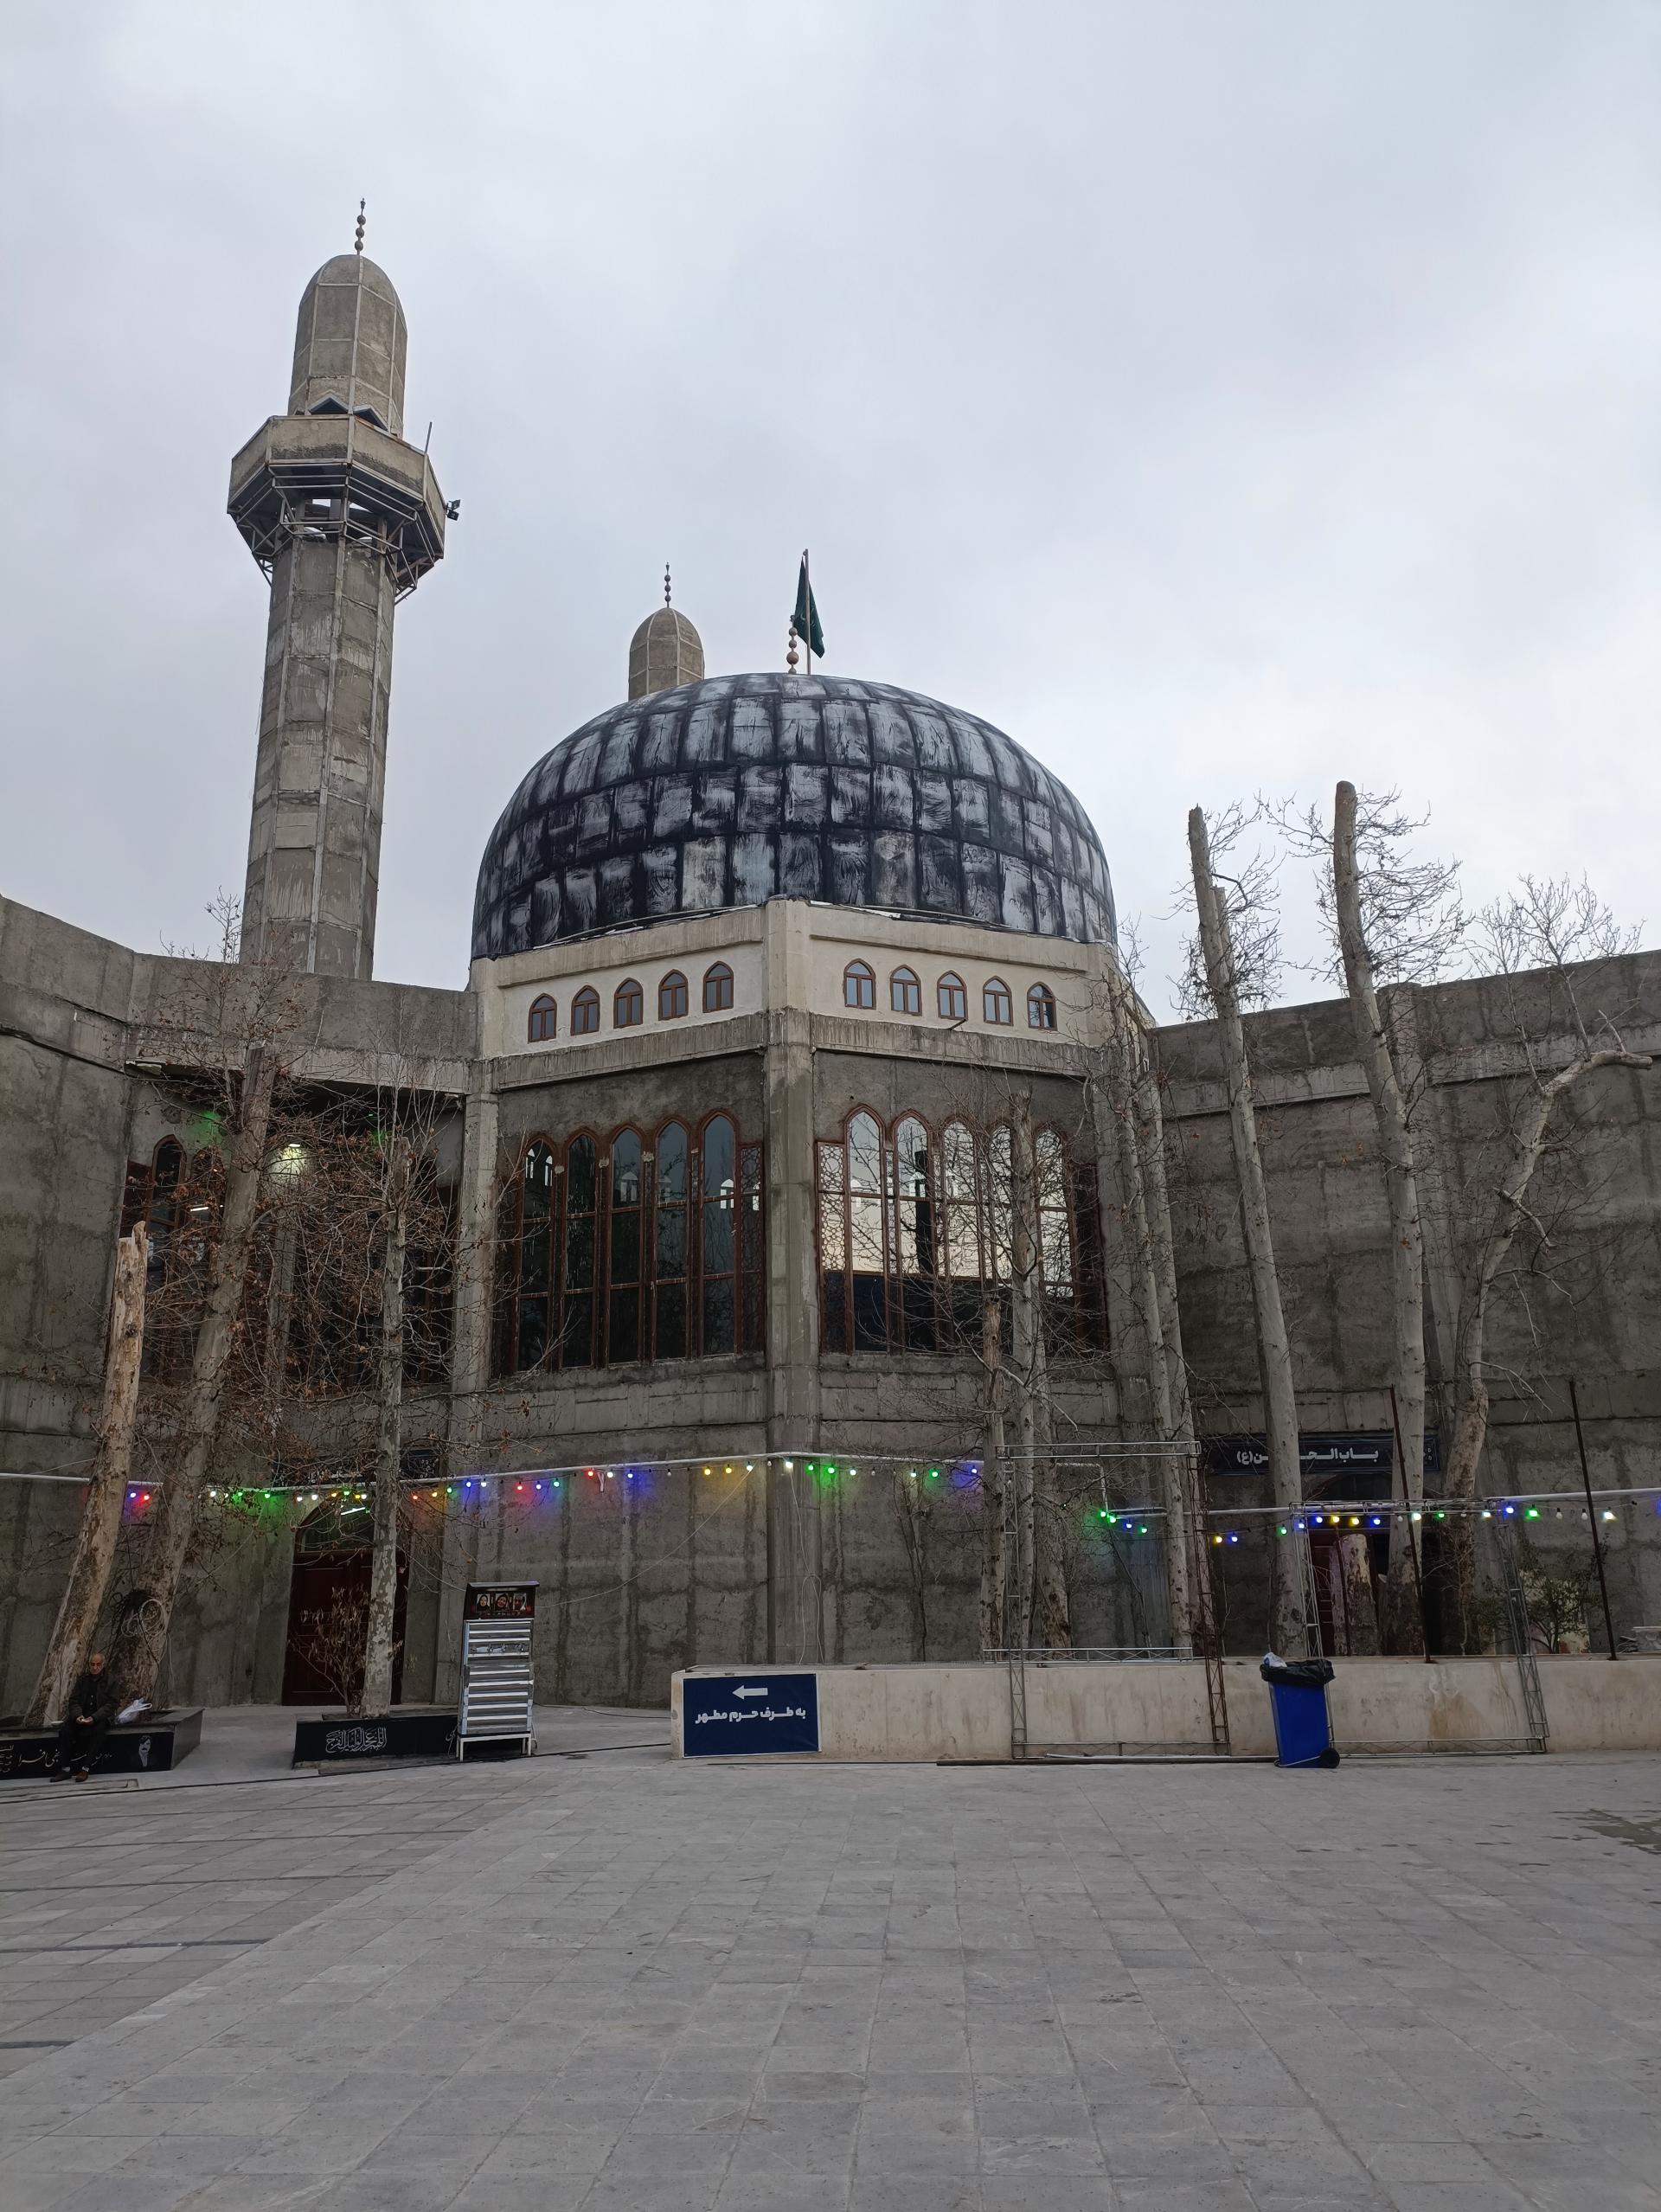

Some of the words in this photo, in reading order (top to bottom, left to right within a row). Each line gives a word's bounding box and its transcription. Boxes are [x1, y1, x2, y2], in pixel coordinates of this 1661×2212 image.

[1338, 1447, 1379, 1463] باب
[695, 1709, 728, 1724] مطهر
[728, 1710, 760, 1722] حرم
[760, 1707, 794, 1722] طرف
[795, 1708, 806, 1720] به
